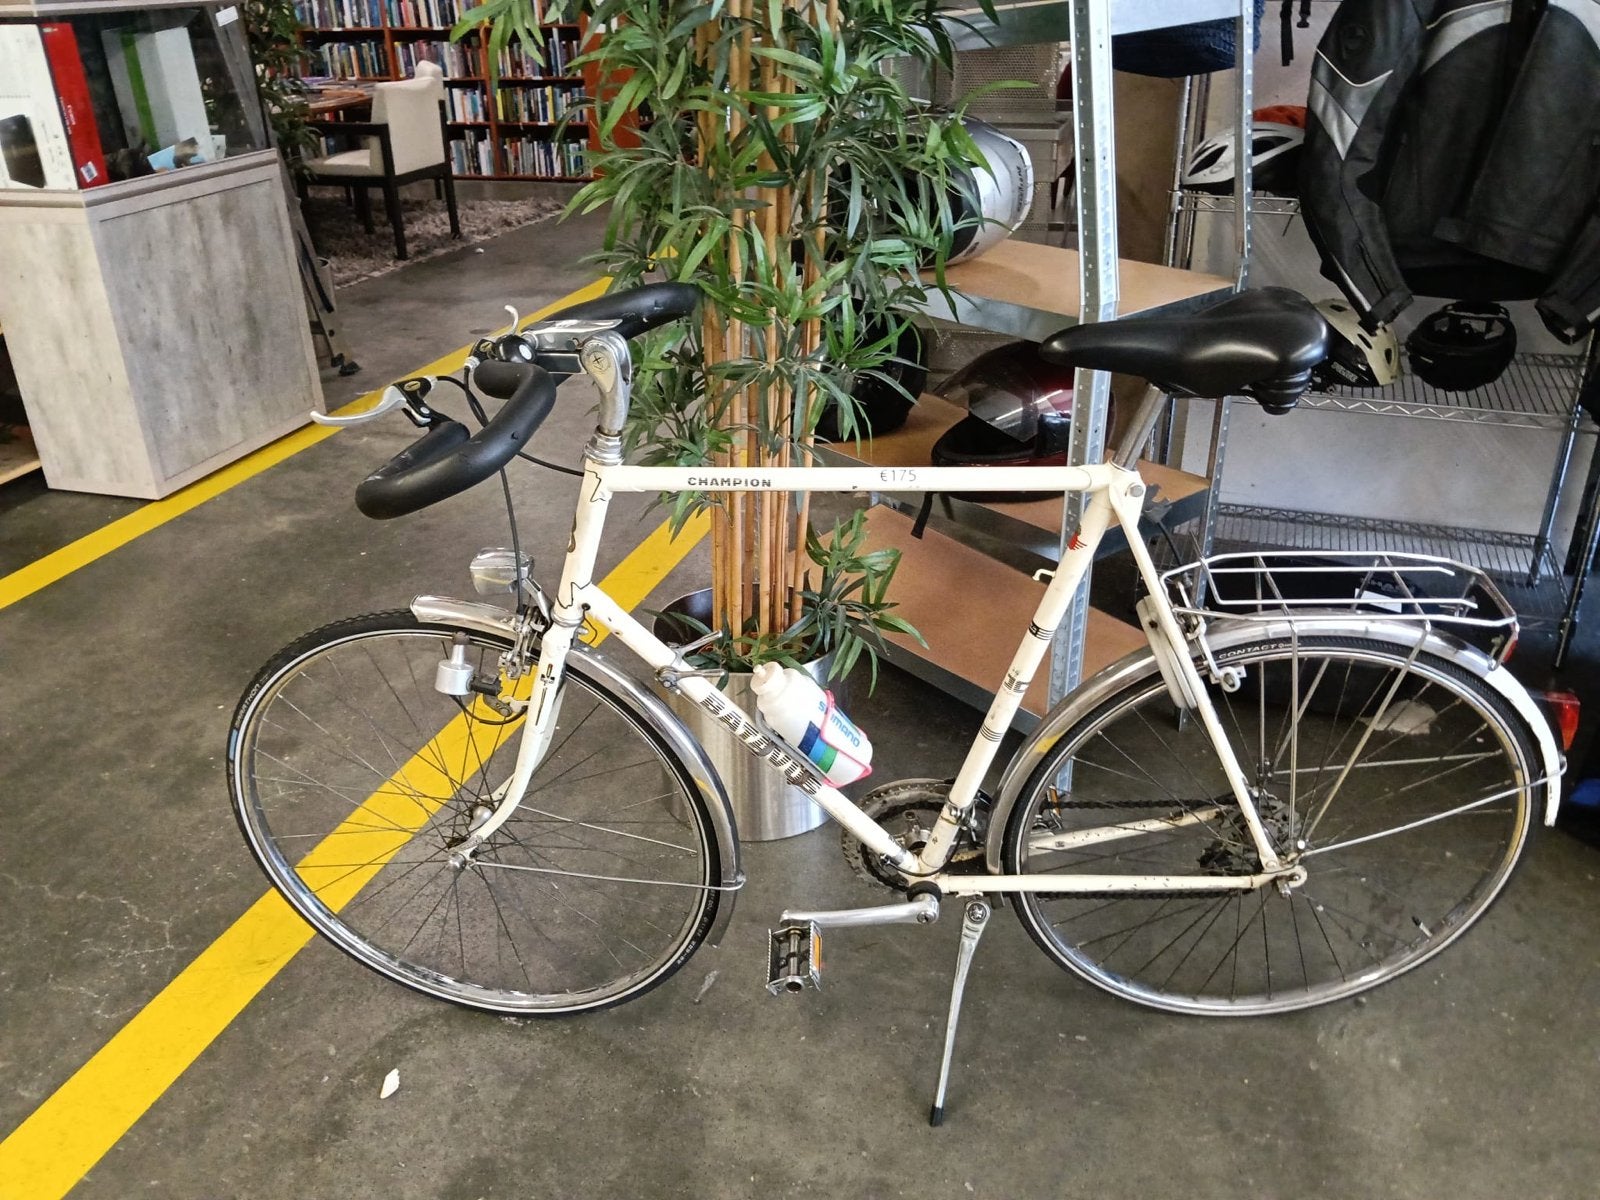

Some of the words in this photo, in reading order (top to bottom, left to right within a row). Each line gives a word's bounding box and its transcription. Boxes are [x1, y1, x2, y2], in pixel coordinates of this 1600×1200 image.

[687, 477, 772, 488] CHAMPION
[880, 469, 917, 482] €175
[1219, 643, 1278, 659] CONTACT
[700, 692, 823, 795] BATAVUS
